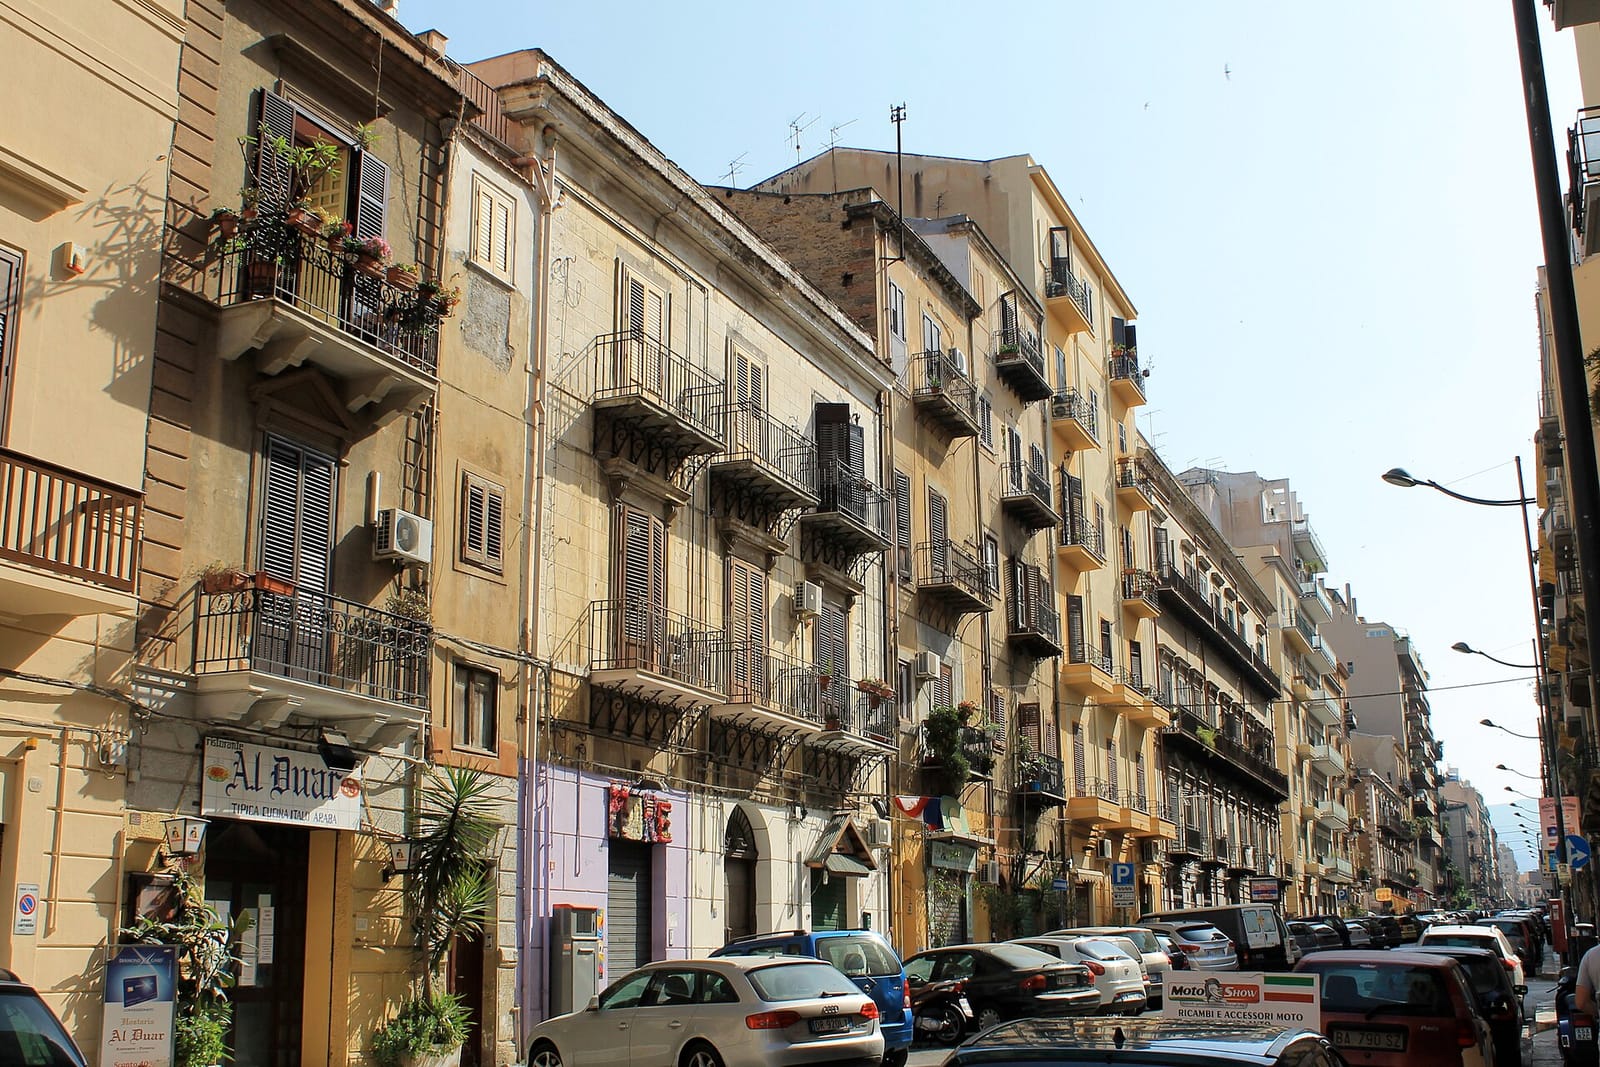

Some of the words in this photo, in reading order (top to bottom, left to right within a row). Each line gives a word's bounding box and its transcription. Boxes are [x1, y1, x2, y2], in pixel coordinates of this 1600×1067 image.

[205, 737, 244, 751] ristorante
[225, 750, 264, 797] Al
[269, 754, 343, 801] Duar
[231, 802, 259, 816] TIPICA
[262, 806, 288, 819] CUCINA
[313, 811, 337, 825] ARABA
[1117, 865, 1130, 883] P
[1171, 985, 1205, 997] Moto
[1178, 1009, 1214, 1018] RICAMBI
[1217, 1010, 1222, 1018] E
[1224, 1011, 1274, 1020] ACCESSORI
[1276, 1013, 1304, 1022] MOTO
[108, 1029, 126, 1046] Al
[130, 1028, 165, 1044] Duar
[1336, 1031, 1351, 1045] BA
[1358, 1032, 1381, 1046] 790
[1386, 1034, 1401, 1048] SZ
